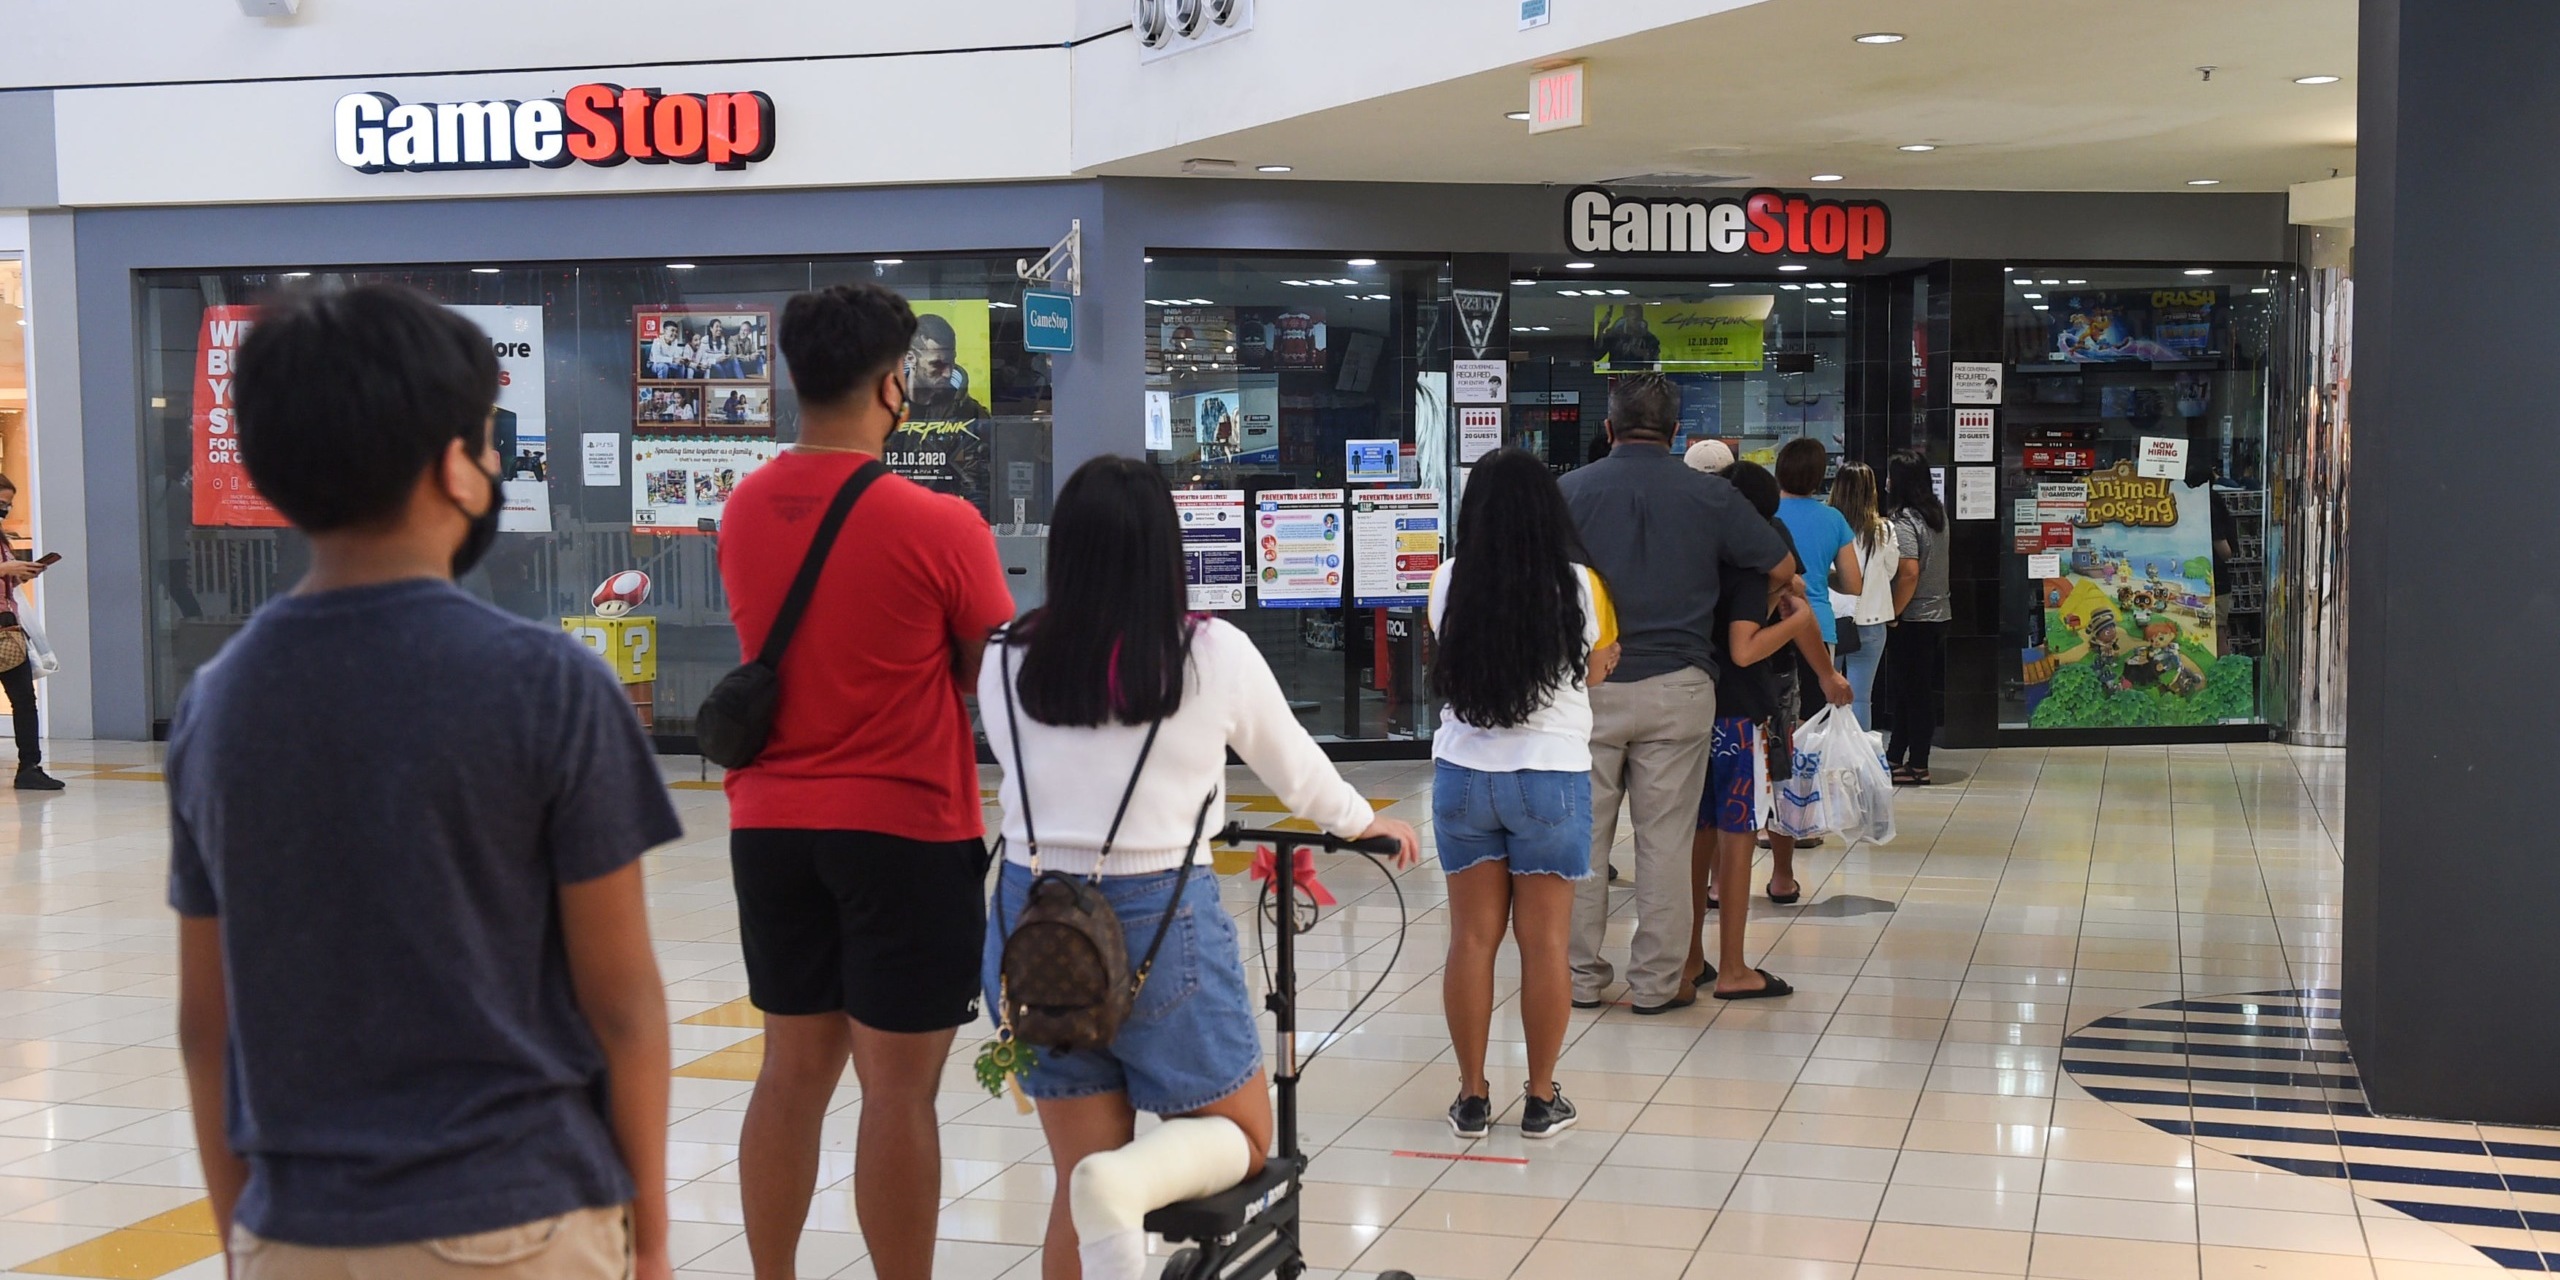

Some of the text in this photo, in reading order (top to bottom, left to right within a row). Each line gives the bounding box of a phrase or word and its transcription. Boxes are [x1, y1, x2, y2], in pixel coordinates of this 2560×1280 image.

[1538, 73, 1576, 123] EXIT
[334, 83, 761, 168] GameStop
[1570, 190, 1887, 260] GameStop
[2151, 290, 2215, 308] CRASH
[1030, 310, 1068, 334] GameStop
[1662, 313, 1754, 330] CYBERPUNK
[1688, 337, 1728, 346] 12.10.2020
[1456, 371, 1490, 379] REQUIRED
[898, 418, 980, 443] ERPUNK
[209, 438, 238, 451] FOR
[655, 447, 681, 455] Spending
[696, 447, 719, 455] together
[2152, 441, 2174, 449] NOW
[208, 451, 230, 463] OR
[886, 451, 947, 466] 12.10.2020
[2147, 449, 2178, 457] HIRING
[2082, 476, 2166, 500] Animal
[1359, 493, 1394, 501] PREVENTION
[1263, 503, 1276, 511] TIPS
[2086, 497, 2175, 523] rossing
[1386, 620, 1408, 637] TROL
